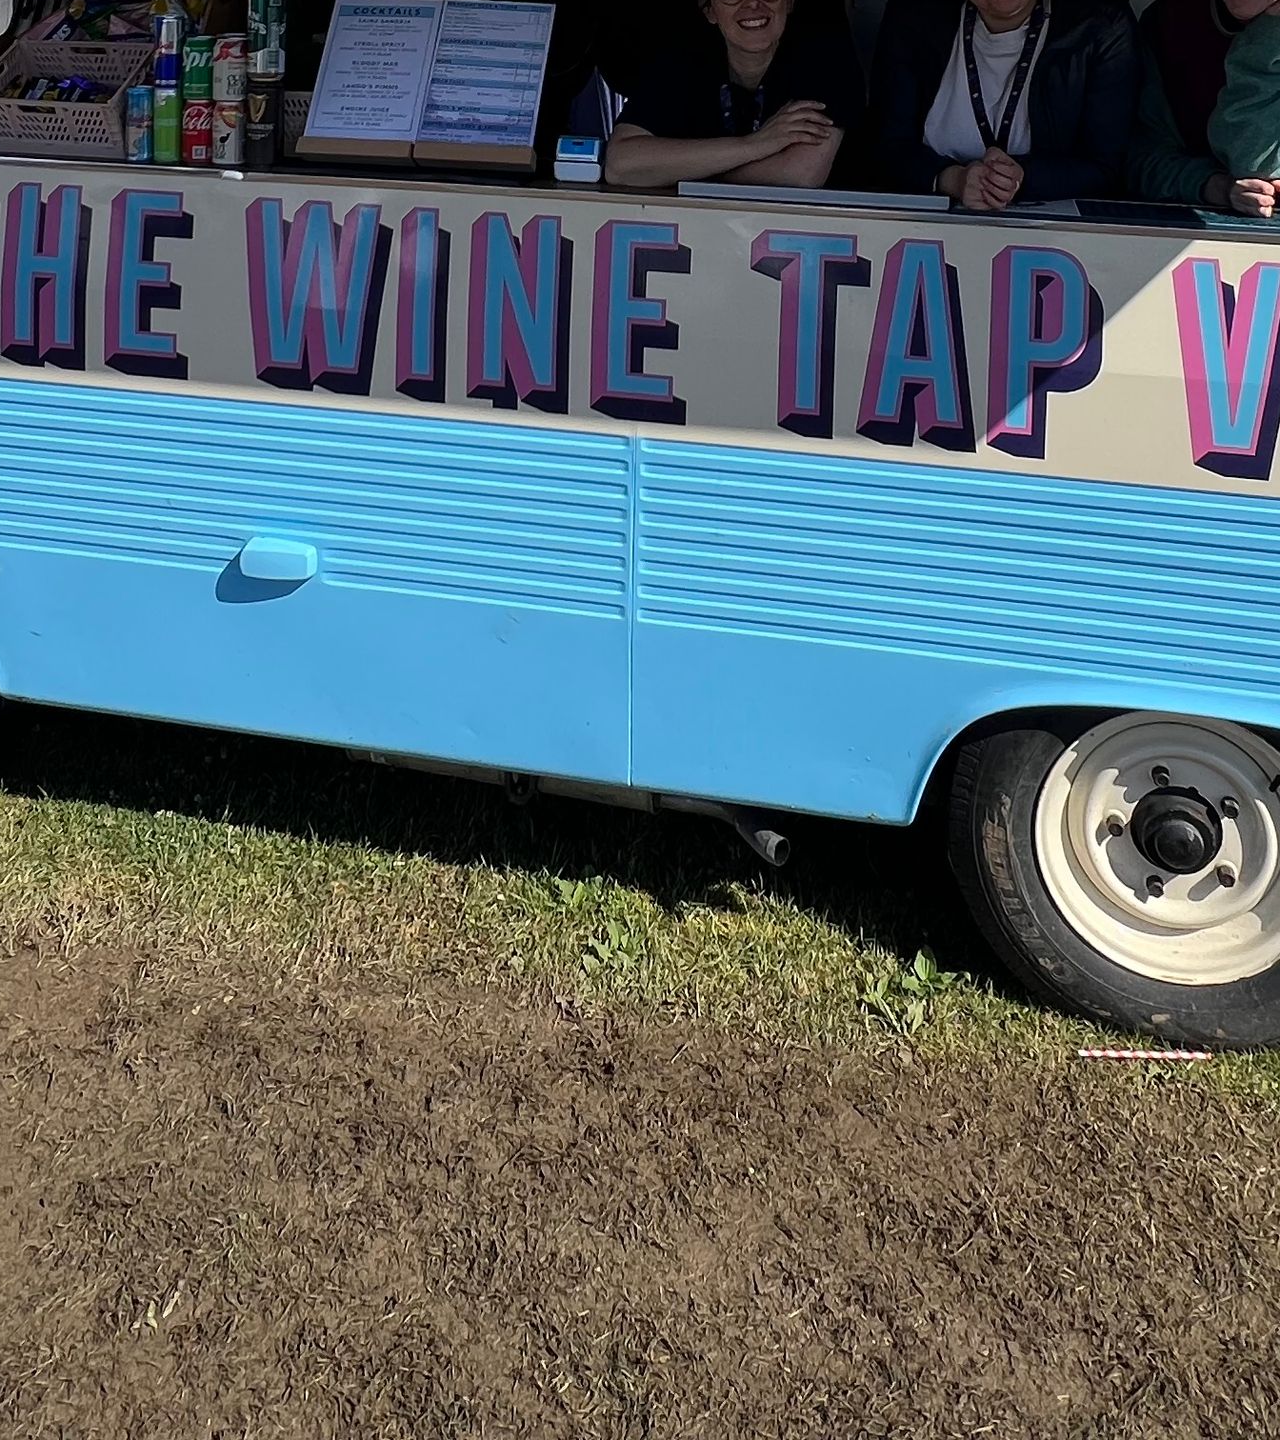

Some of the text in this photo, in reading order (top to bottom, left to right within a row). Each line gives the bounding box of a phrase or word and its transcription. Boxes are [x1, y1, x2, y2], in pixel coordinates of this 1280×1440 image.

[353, 7, 421, 17] COCKTAILS
[246, 196, 693, 426] WINE
[750, 227, 1105, 460] TAP
